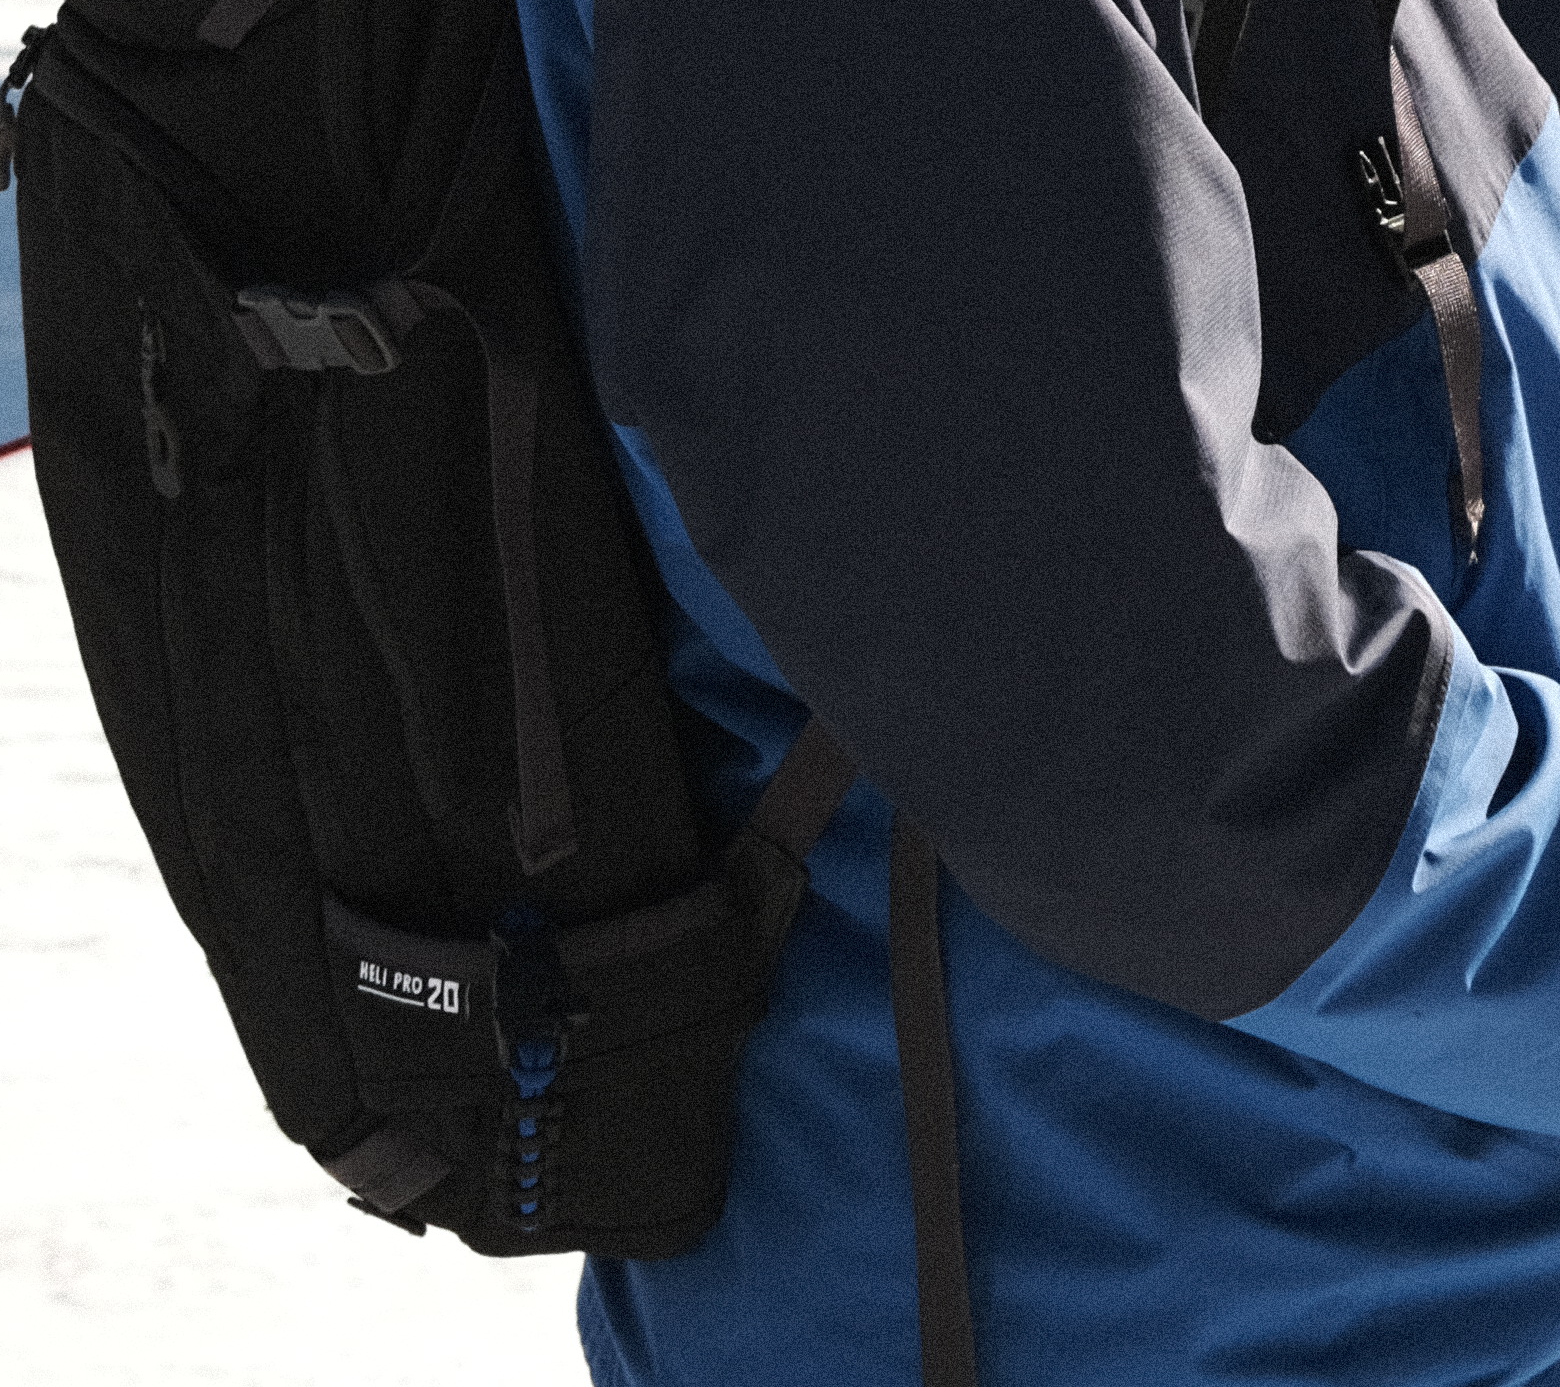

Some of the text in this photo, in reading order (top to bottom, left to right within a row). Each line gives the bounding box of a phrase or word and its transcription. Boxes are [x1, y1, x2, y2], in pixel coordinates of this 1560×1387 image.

[359, 960, 461, 1015] HELI PRO 20
